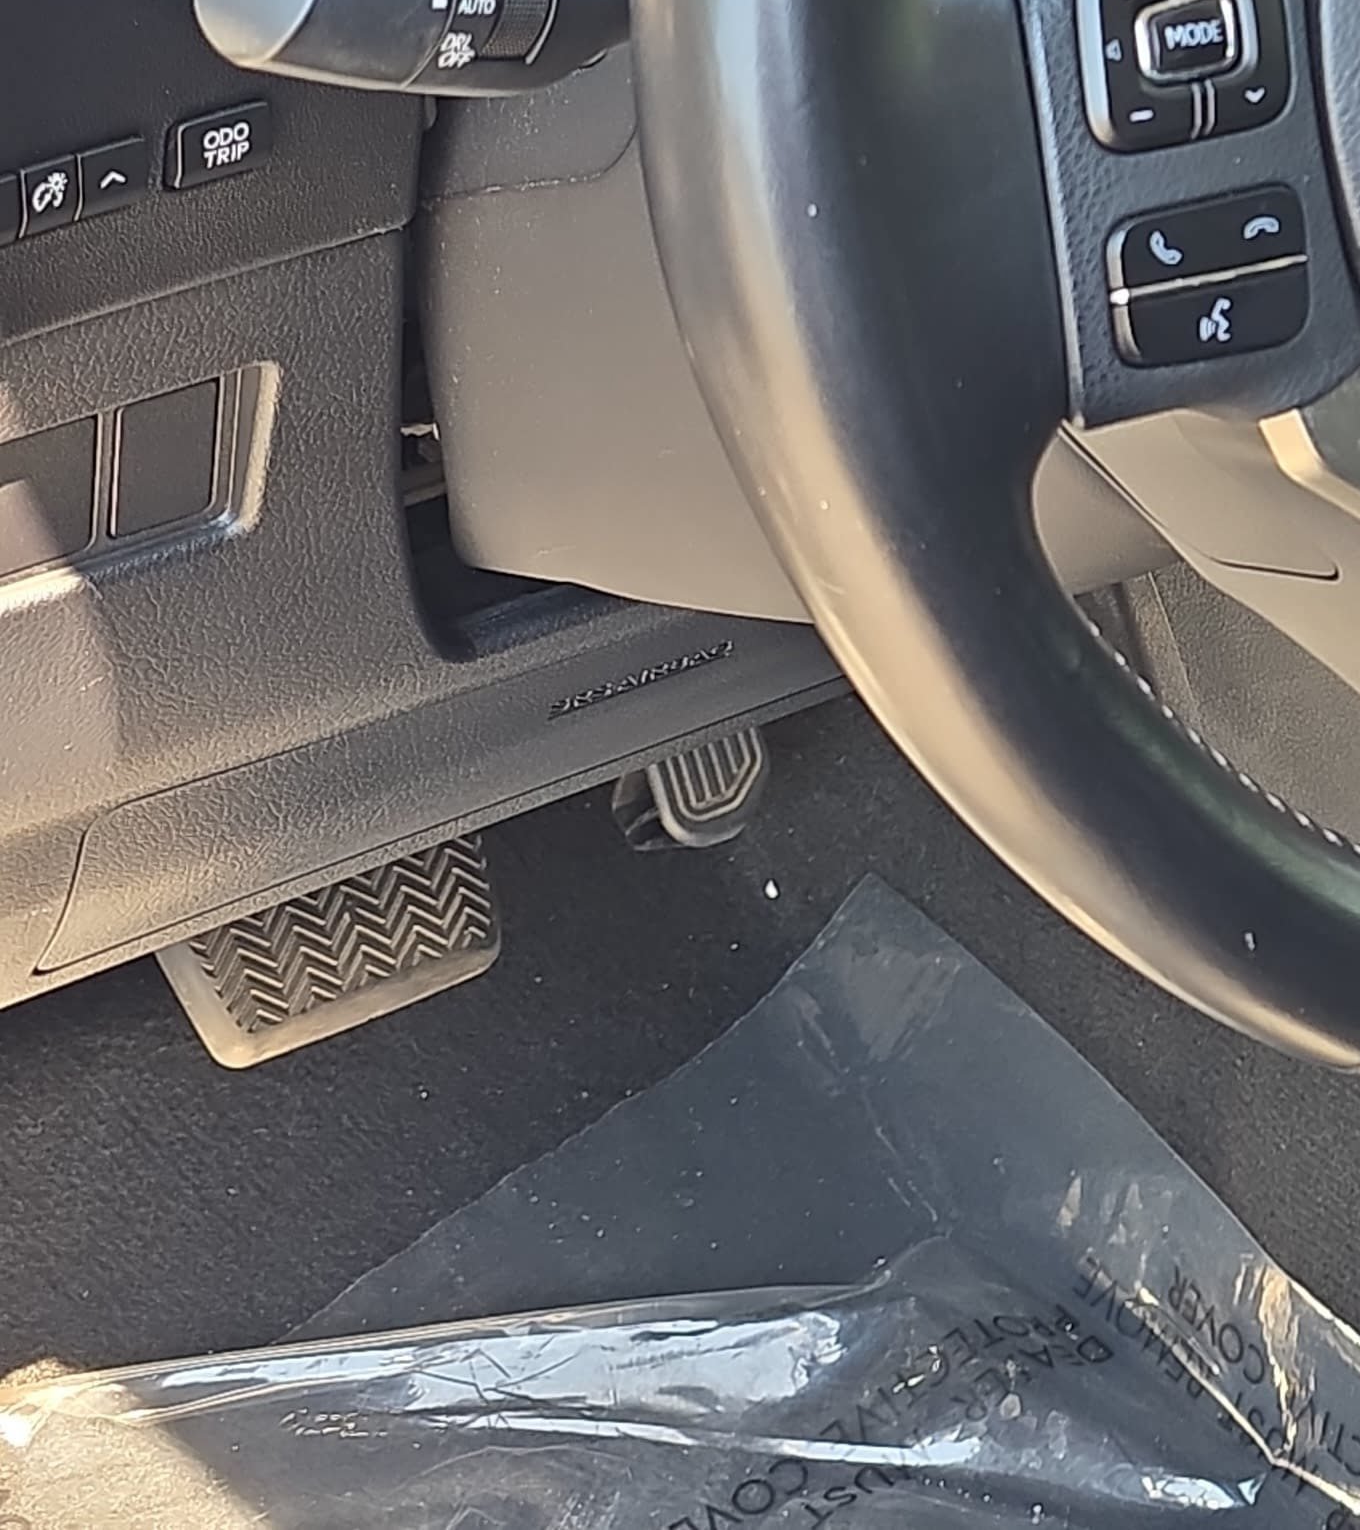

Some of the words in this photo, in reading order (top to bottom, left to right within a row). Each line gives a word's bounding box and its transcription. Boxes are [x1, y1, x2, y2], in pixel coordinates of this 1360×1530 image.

[439, 32, 473, 52] DRL
[1163, 21, 1225, 50] MODE
[437, 49, 476, 69] OFF
[203, 121, 250, 149] ODO
[203, 141, 250, 169] TRIP
[1167, 1267, 1265, 1385] COVER
[801, 1443, 921, 1530] UST
